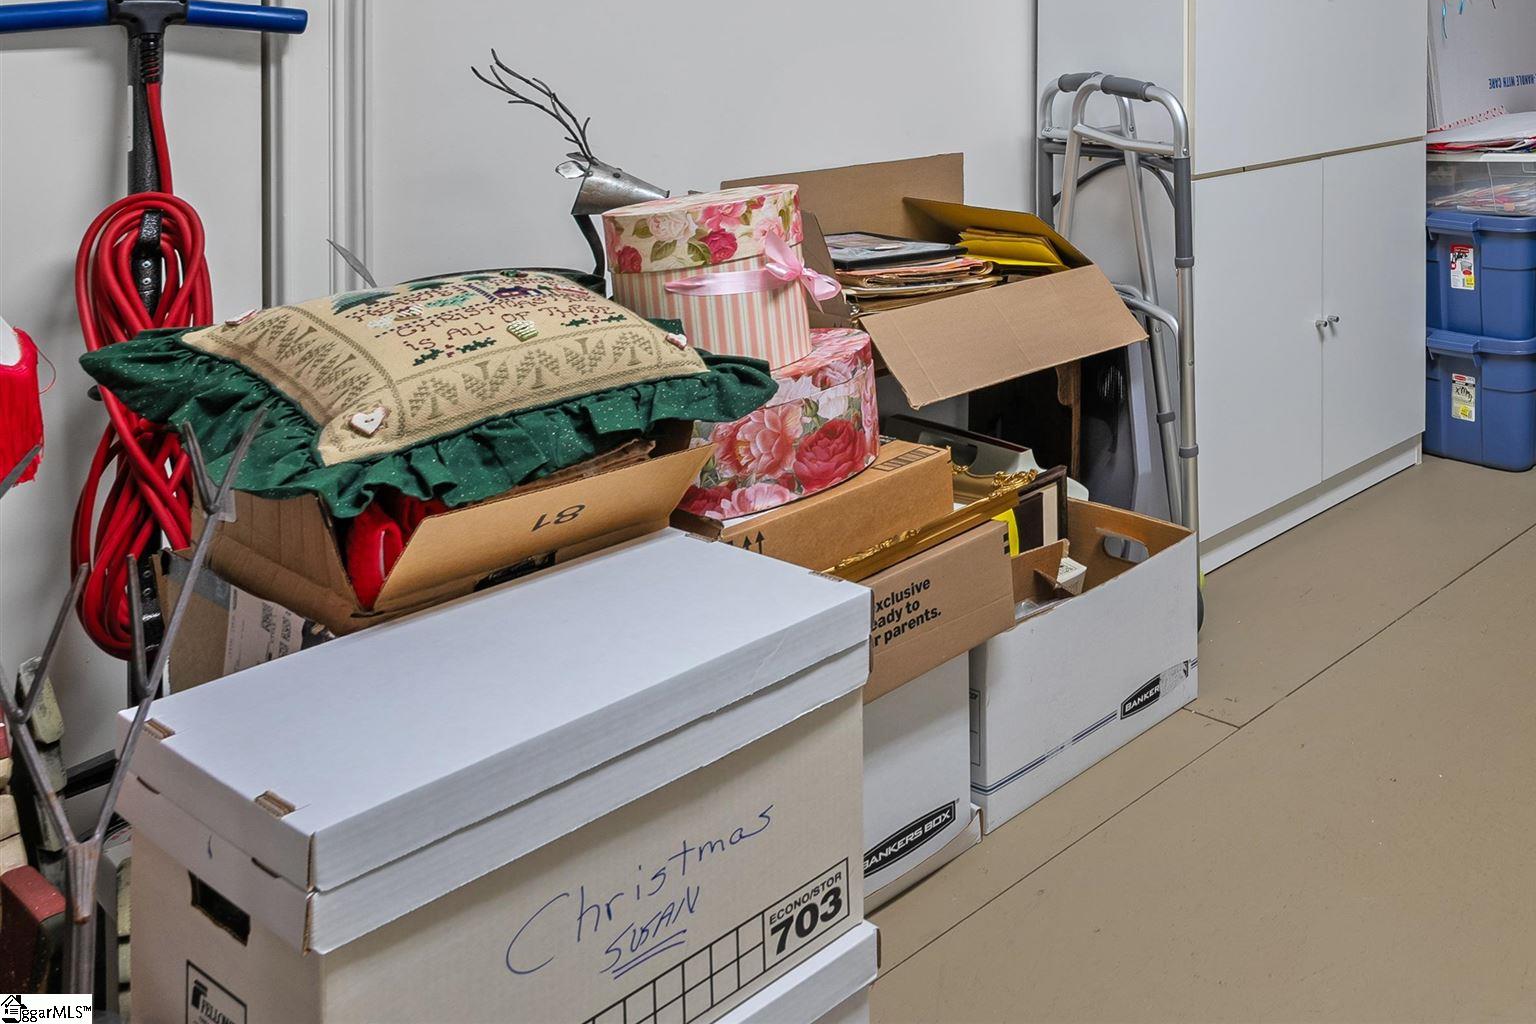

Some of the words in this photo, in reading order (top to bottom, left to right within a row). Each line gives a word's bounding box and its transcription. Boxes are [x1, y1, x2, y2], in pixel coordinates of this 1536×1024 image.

[1488, 78, 1502, 90] CARE
[875, 578, 931, 613] xclusive
[871, 607, 903, 632] eady
[905, 600, 920, 614] to
[884, 607, 942, 645] parents.
[1125, 684, 1160, 712] BANKER
[924, 809, 950, 833] BOX
[505, 804, 774, 975] Christmas
[769, 871, 843, 925] ECONO/STOR
[770, 886, 843, 956] 703
